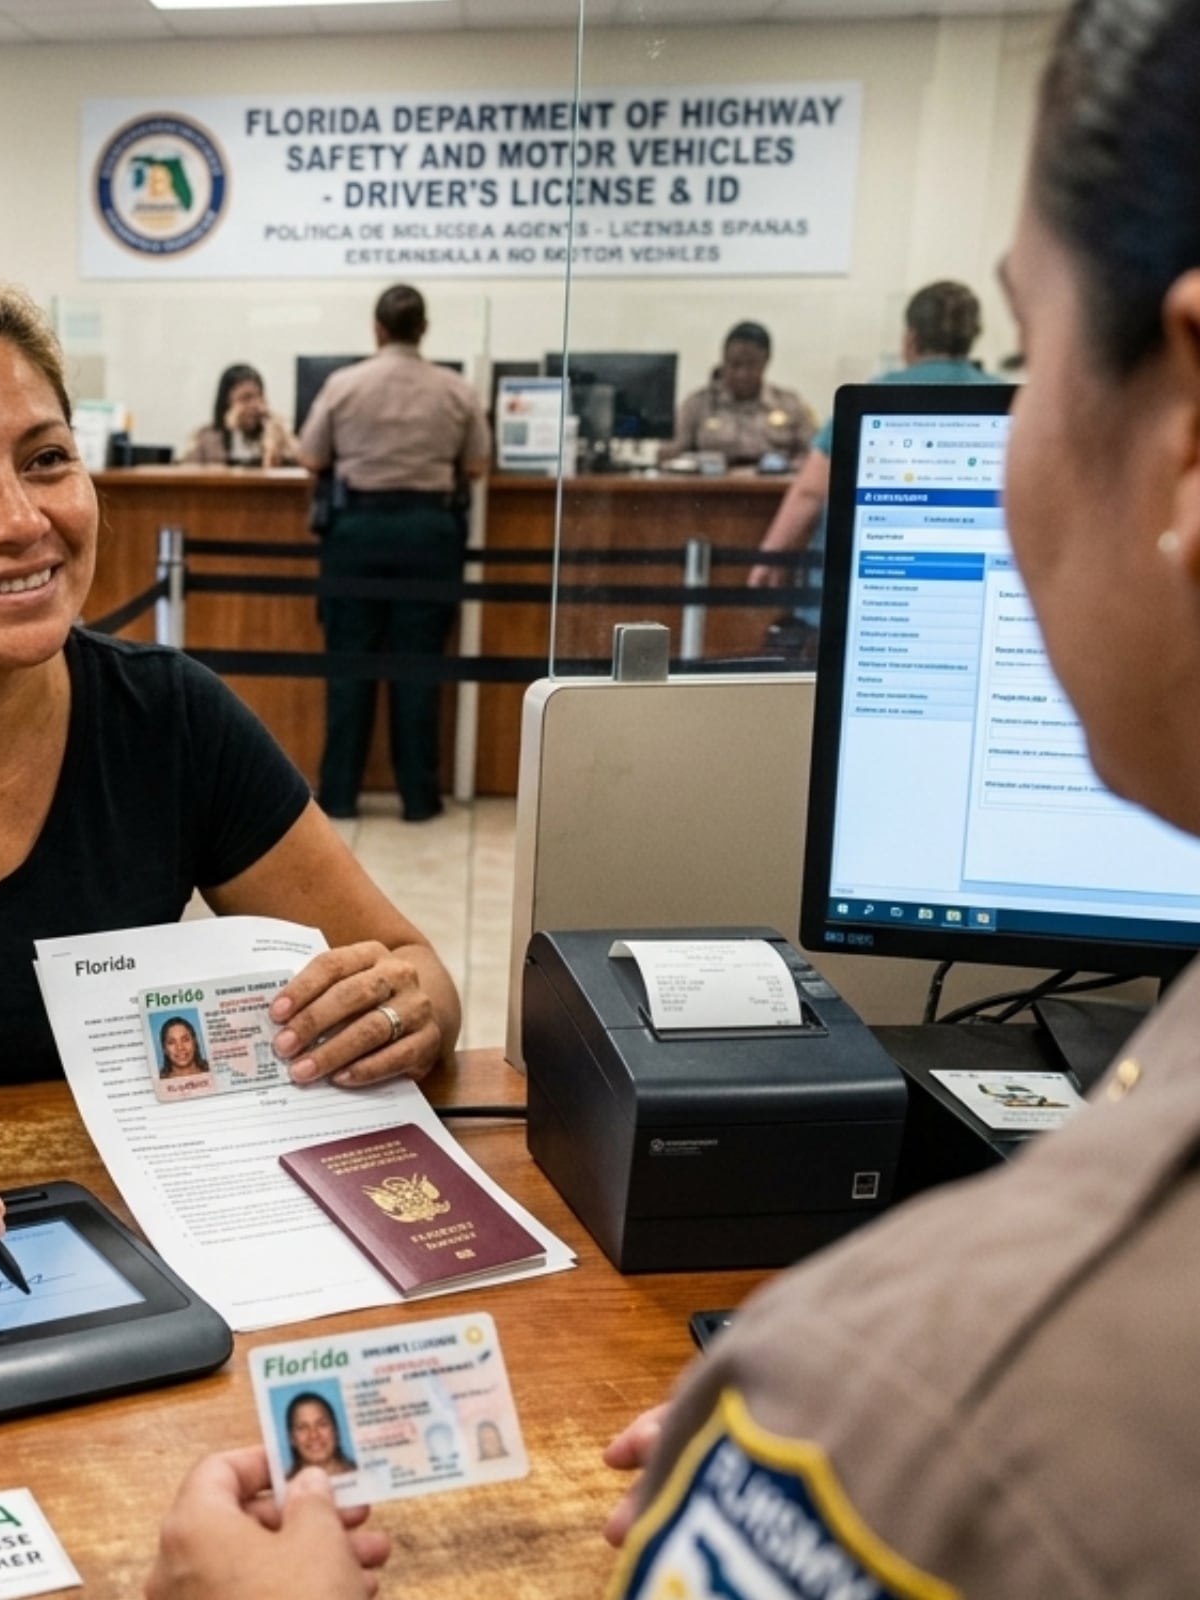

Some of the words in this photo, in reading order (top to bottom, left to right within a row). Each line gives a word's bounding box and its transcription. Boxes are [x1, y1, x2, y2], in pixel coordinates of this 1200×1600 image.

[245, 108, 381, 136] FLORIDA
[393, 102, 614, 133] DEPARTMENT
[625, 100, 670, 129] OF
[681, 97, 843, 128] HIGHWAY
[286, 144, 408, 172] SAFETY
[421, 142, 487, 169] AND
[499, 138, 616, 168] MOTOR
[628, 136, 795, 167] VEHICLES
[344, 179, 499, 208] DRIVER'S
[511, 176, 655, 206] LICENSE
[669, 176, 692, 205] &
[706, 175, 741, 205] ID
[75, 955, 136, 976] Florida
[264, 1347, 350, 1379] Florida
